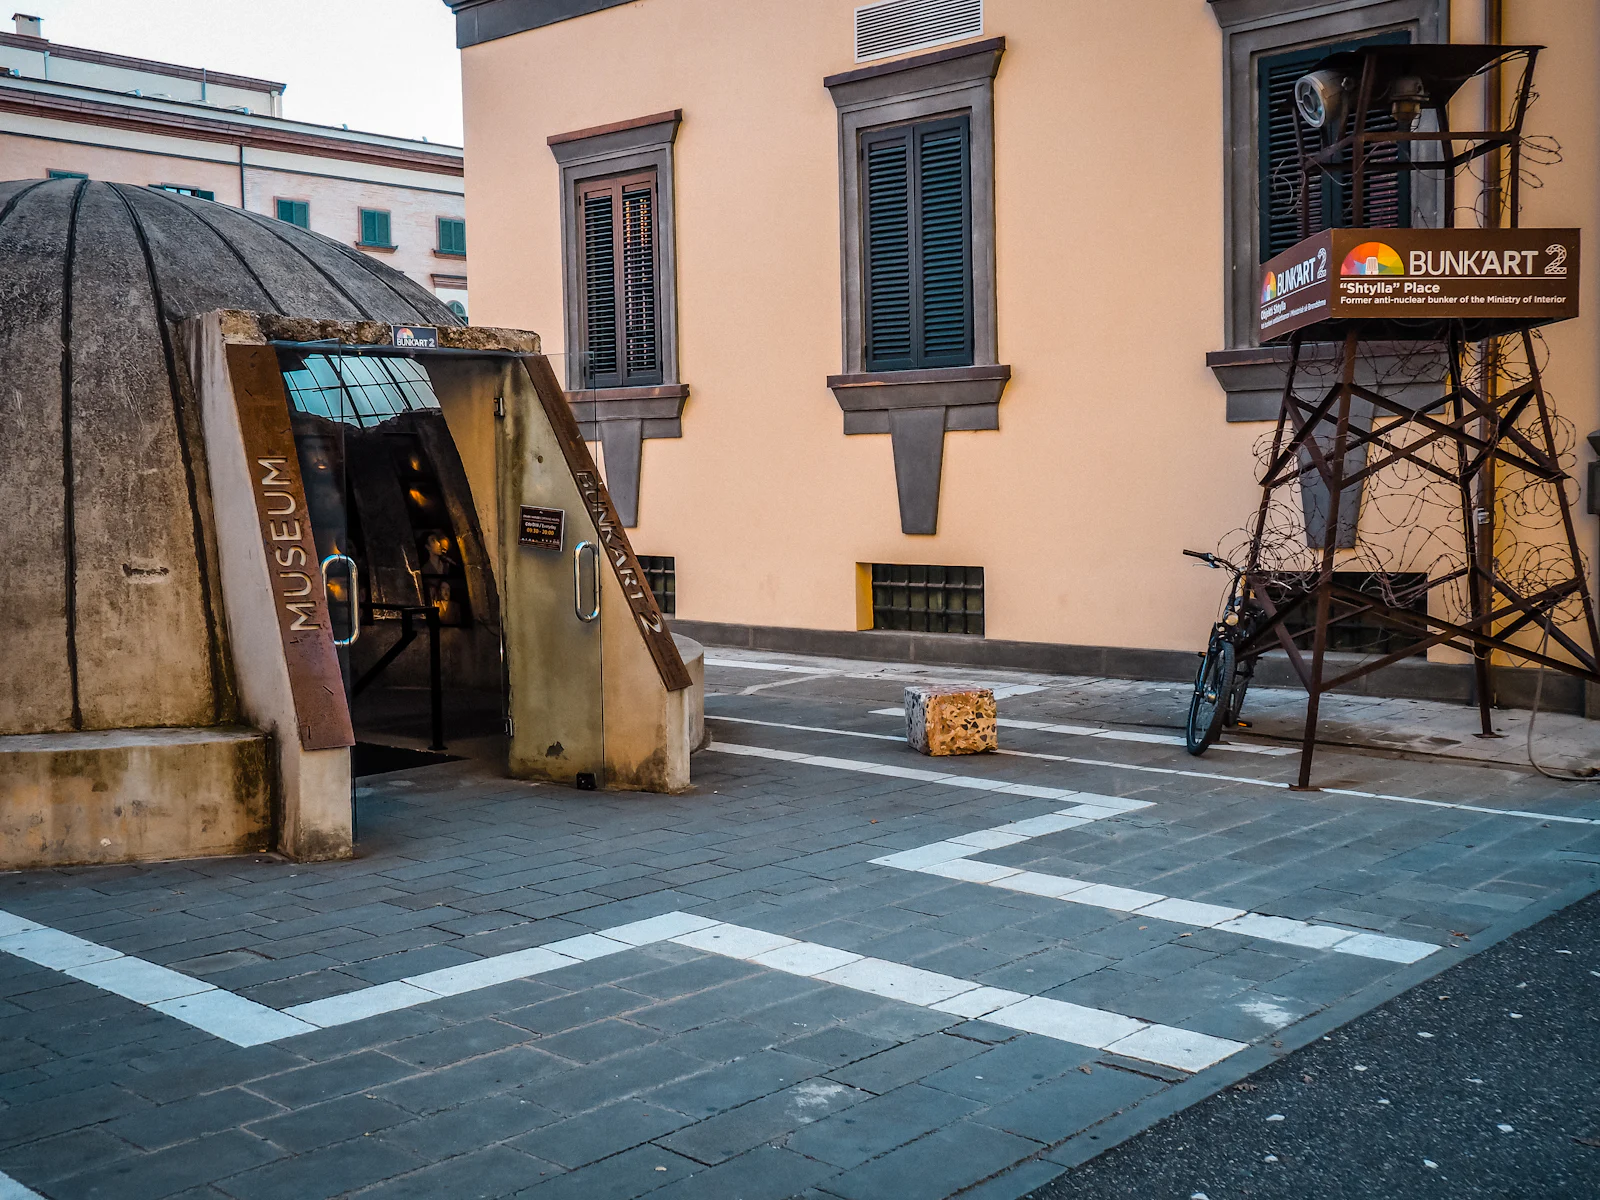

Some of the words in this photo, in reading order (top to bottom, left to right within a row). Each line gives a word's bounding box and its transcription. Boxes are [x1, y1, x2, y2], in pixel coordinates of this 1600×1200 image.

[1277, 257, 1316, 296] BUNK'ART
[1317, 247, 1327, 279] 2
[1409, 250, 1539, 276] BUNK'ART
[1544, 243, 1568, 275] 2
[1340, 282, 1400, 295] “Shtylla”
[1404, 282, 1441, 293] Place
[1340, 296, 1373, 304] Former
[1374, 296, 1426, 304] anti-nuclear
[1427, 296, 1458, 304] bunker
[1460, 296, 1469, 304] of
[1471, 296, 1486, 304] the
[1487, 295, 1521, 305] Ministry
[1523, 296, 1533, 304] of
[1534, 295, 1567, 304] Interior
[396, 338, 428, 347] BUNK'ART
[428, 338, 436, 347] 2
[257, 456, 320, 632] MUSEUM
[638, 610, 664, 636] 2
